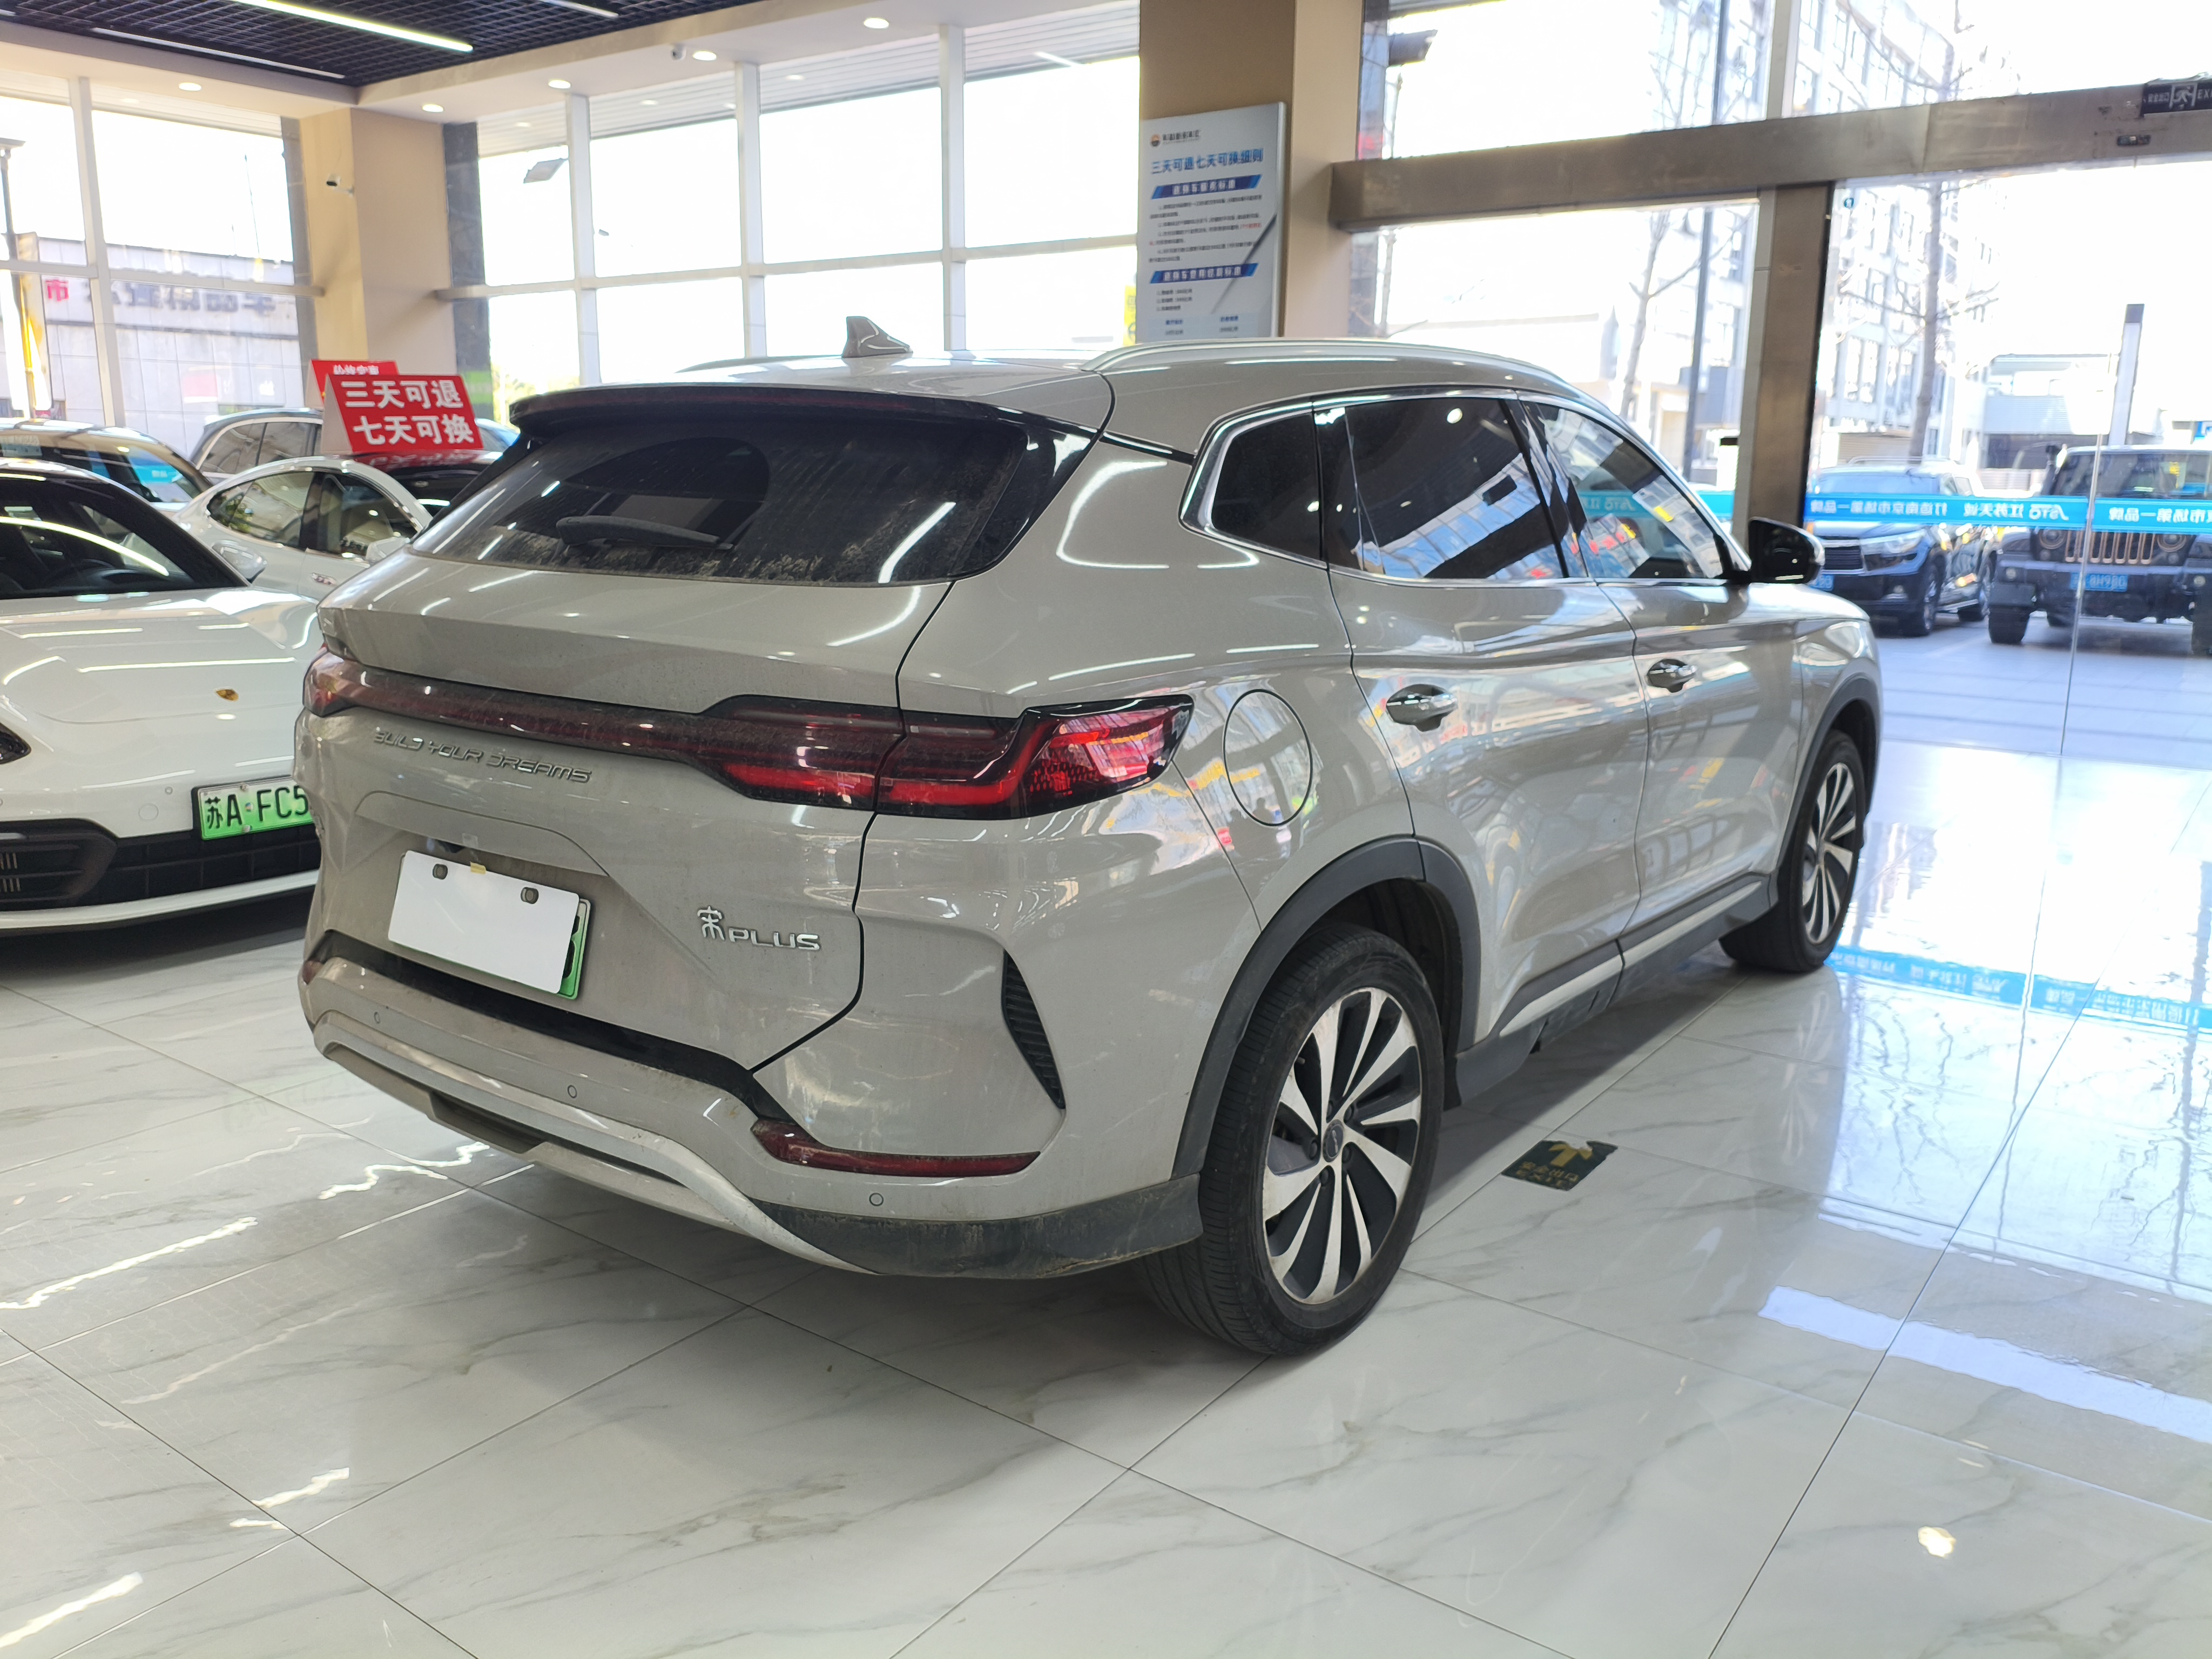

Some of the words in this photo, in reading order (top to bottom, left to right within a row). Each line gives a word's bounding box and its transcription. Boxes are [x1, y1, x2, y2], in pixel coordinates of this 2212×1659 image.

[341, 379, 463, 409] 三天可退
[353, 415, 474, 445] 七天可换
[374, 729, 424, 751] BUILD
[428, 740, 484, 764] YOUR
[486, 752, 592, 784] DREAMS
